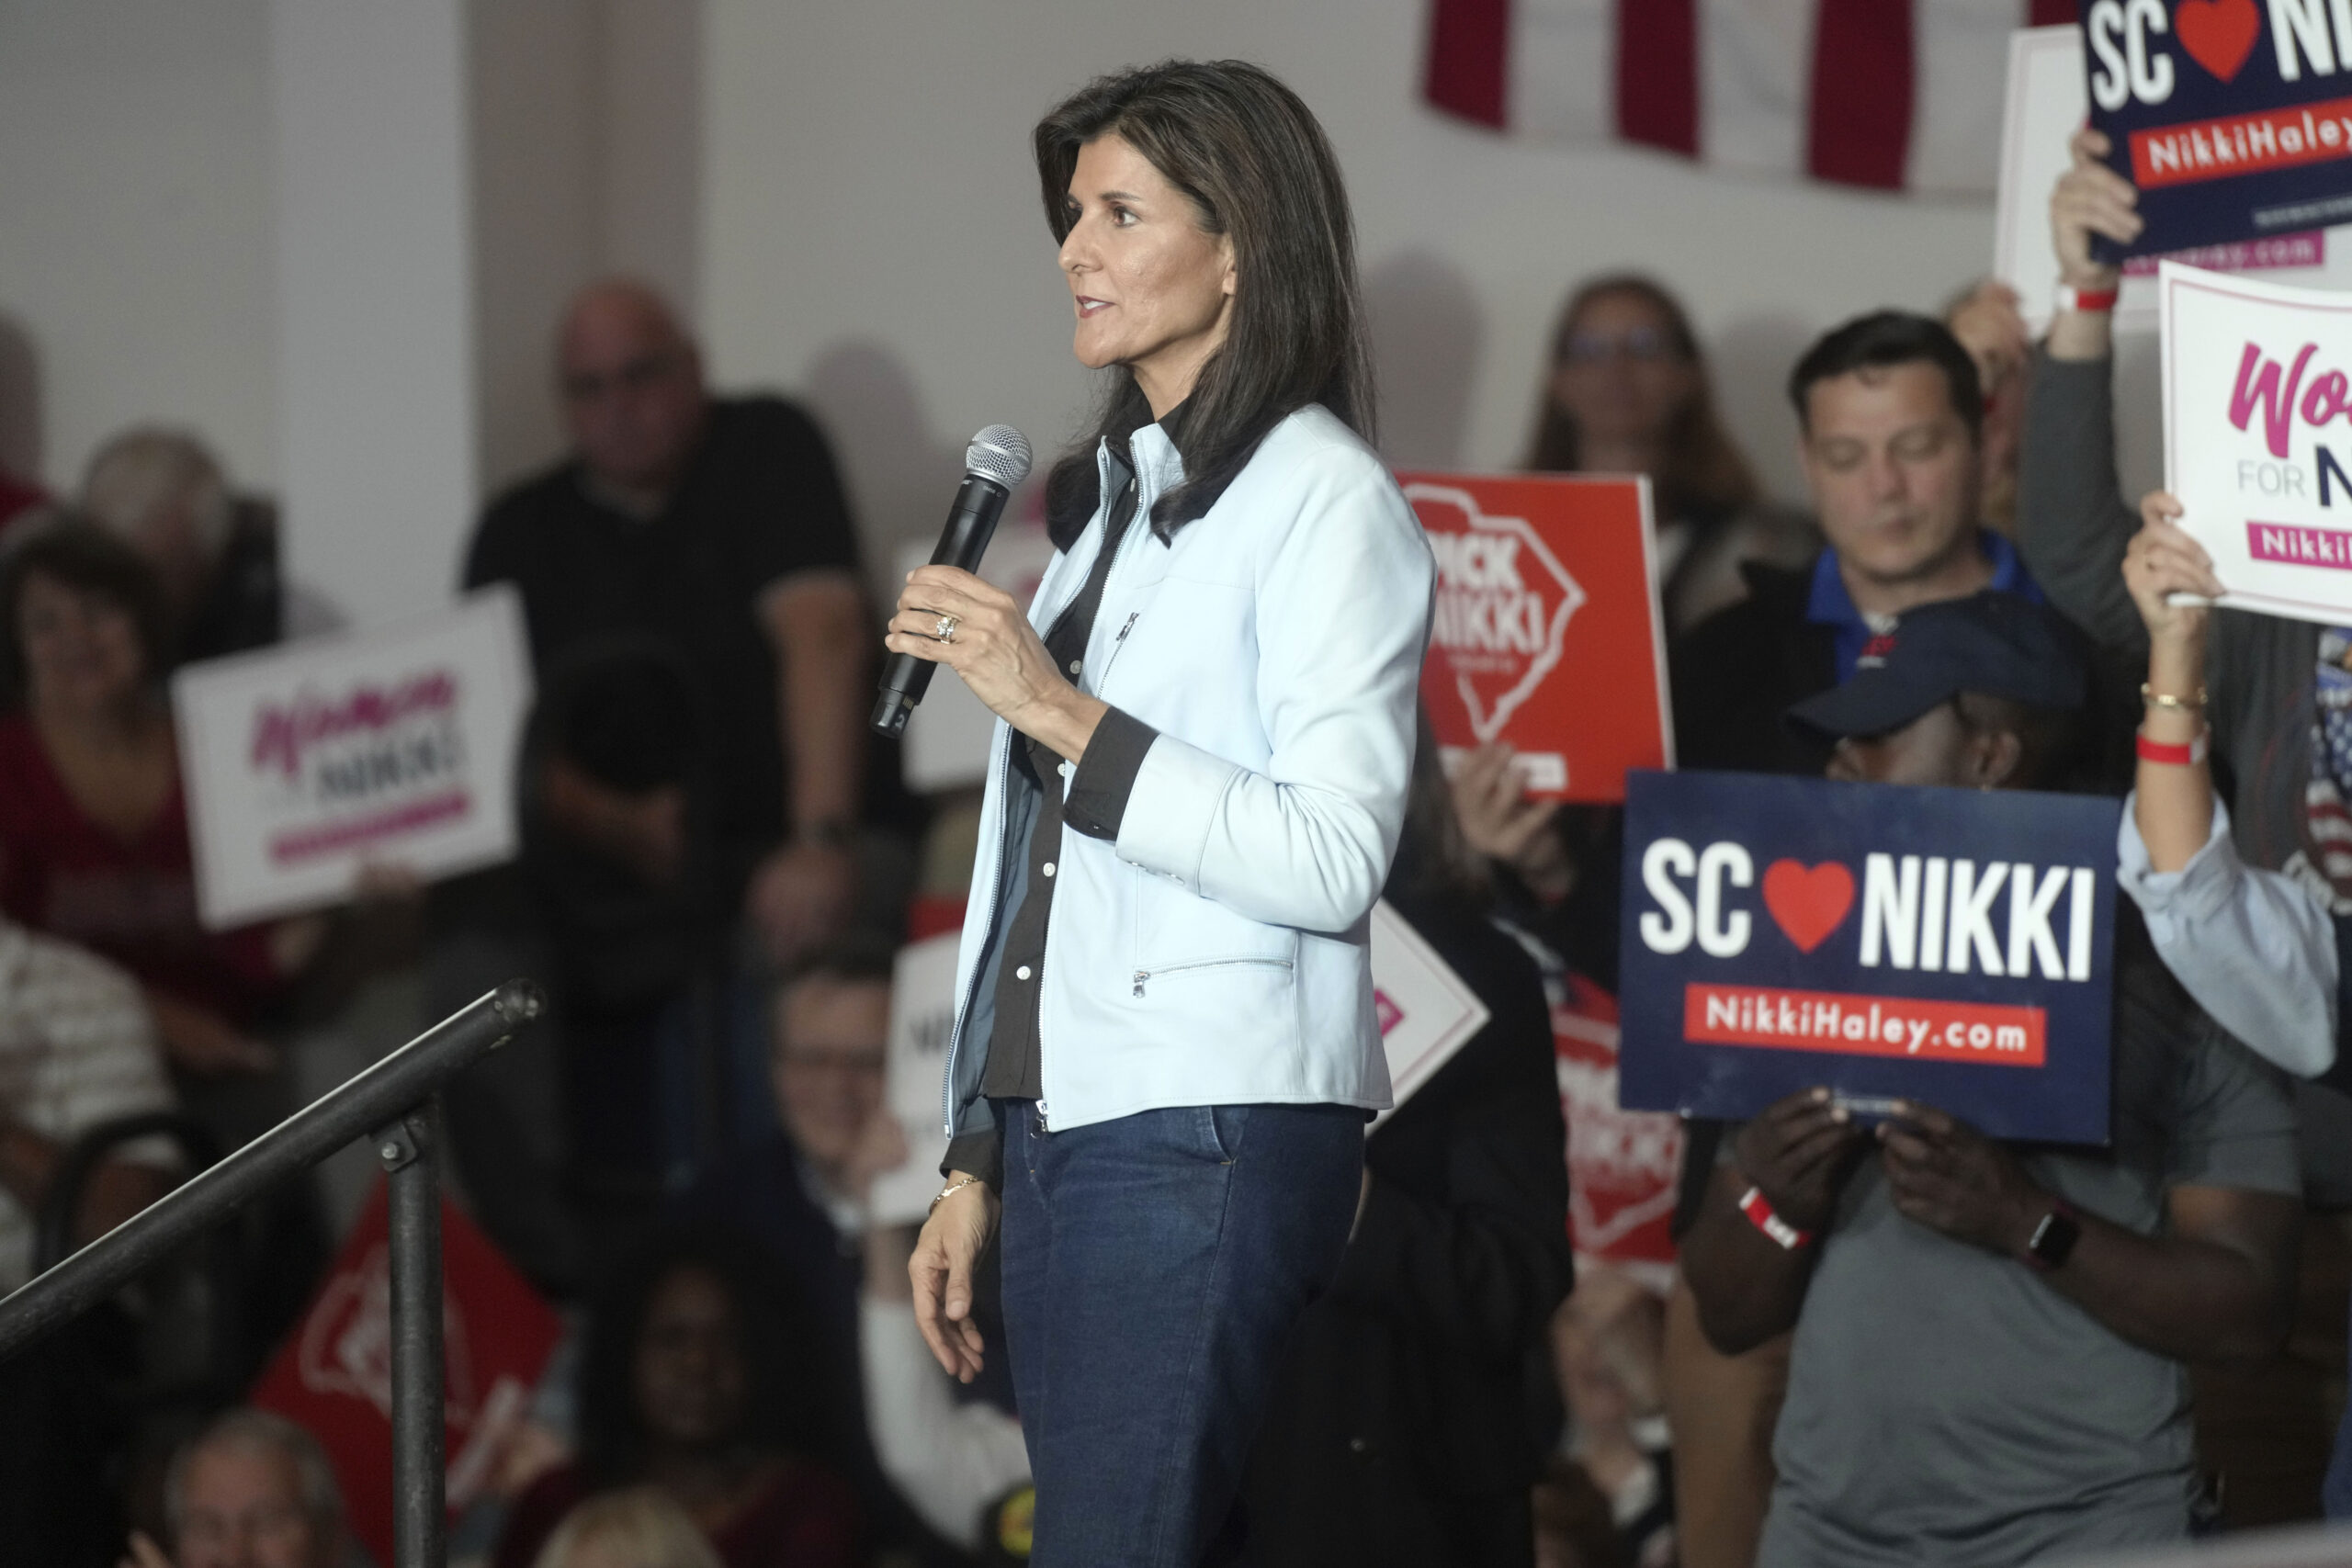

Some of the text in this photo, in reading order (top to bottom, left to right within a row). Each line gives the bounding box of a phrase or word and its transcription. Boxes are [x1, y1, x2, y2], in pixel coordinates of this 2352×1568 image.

[2088, 0, 2175, 111] SC
[2228, 341, 2352, 459] Wo
[2237, 460, 2306, 498] FOR
[2261, 526, 2352, 565] Nikki
[1639, 837, 2095, 982] SC NIKKI
[1705, 994, 2028, 1054] NikkiHaley.com
